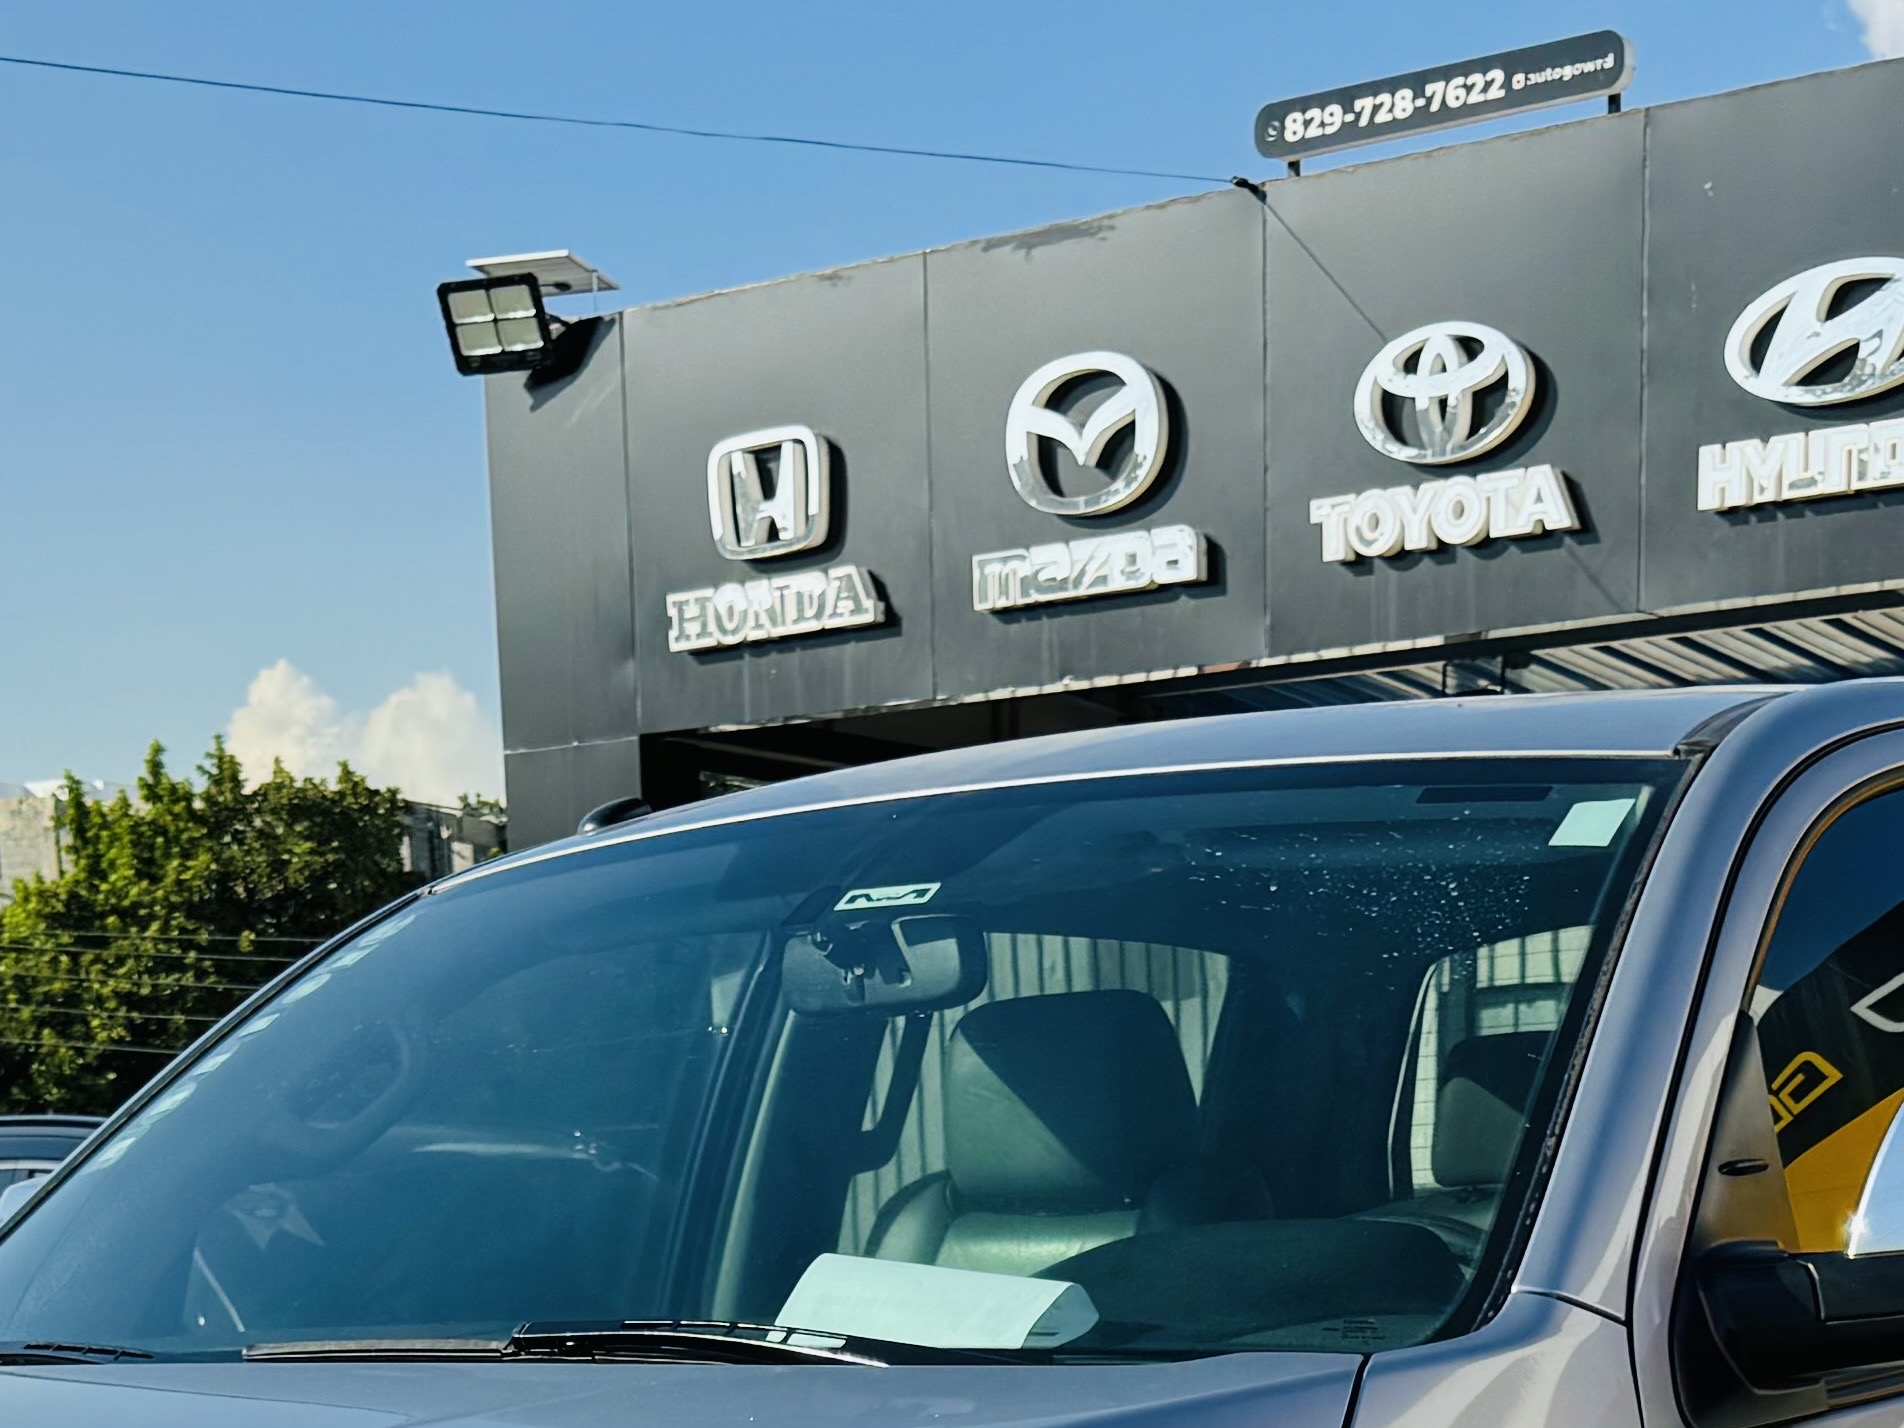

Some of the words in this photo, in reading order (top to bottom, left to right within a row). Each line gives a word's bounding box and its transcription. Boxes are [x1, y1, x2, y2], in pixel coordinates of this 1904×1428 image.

[1283, 68, 1506, 143] 829-728-7622
[1309, 464, 1581, 563] TOYOTA
[666, 564, 884, 652] HONDA
